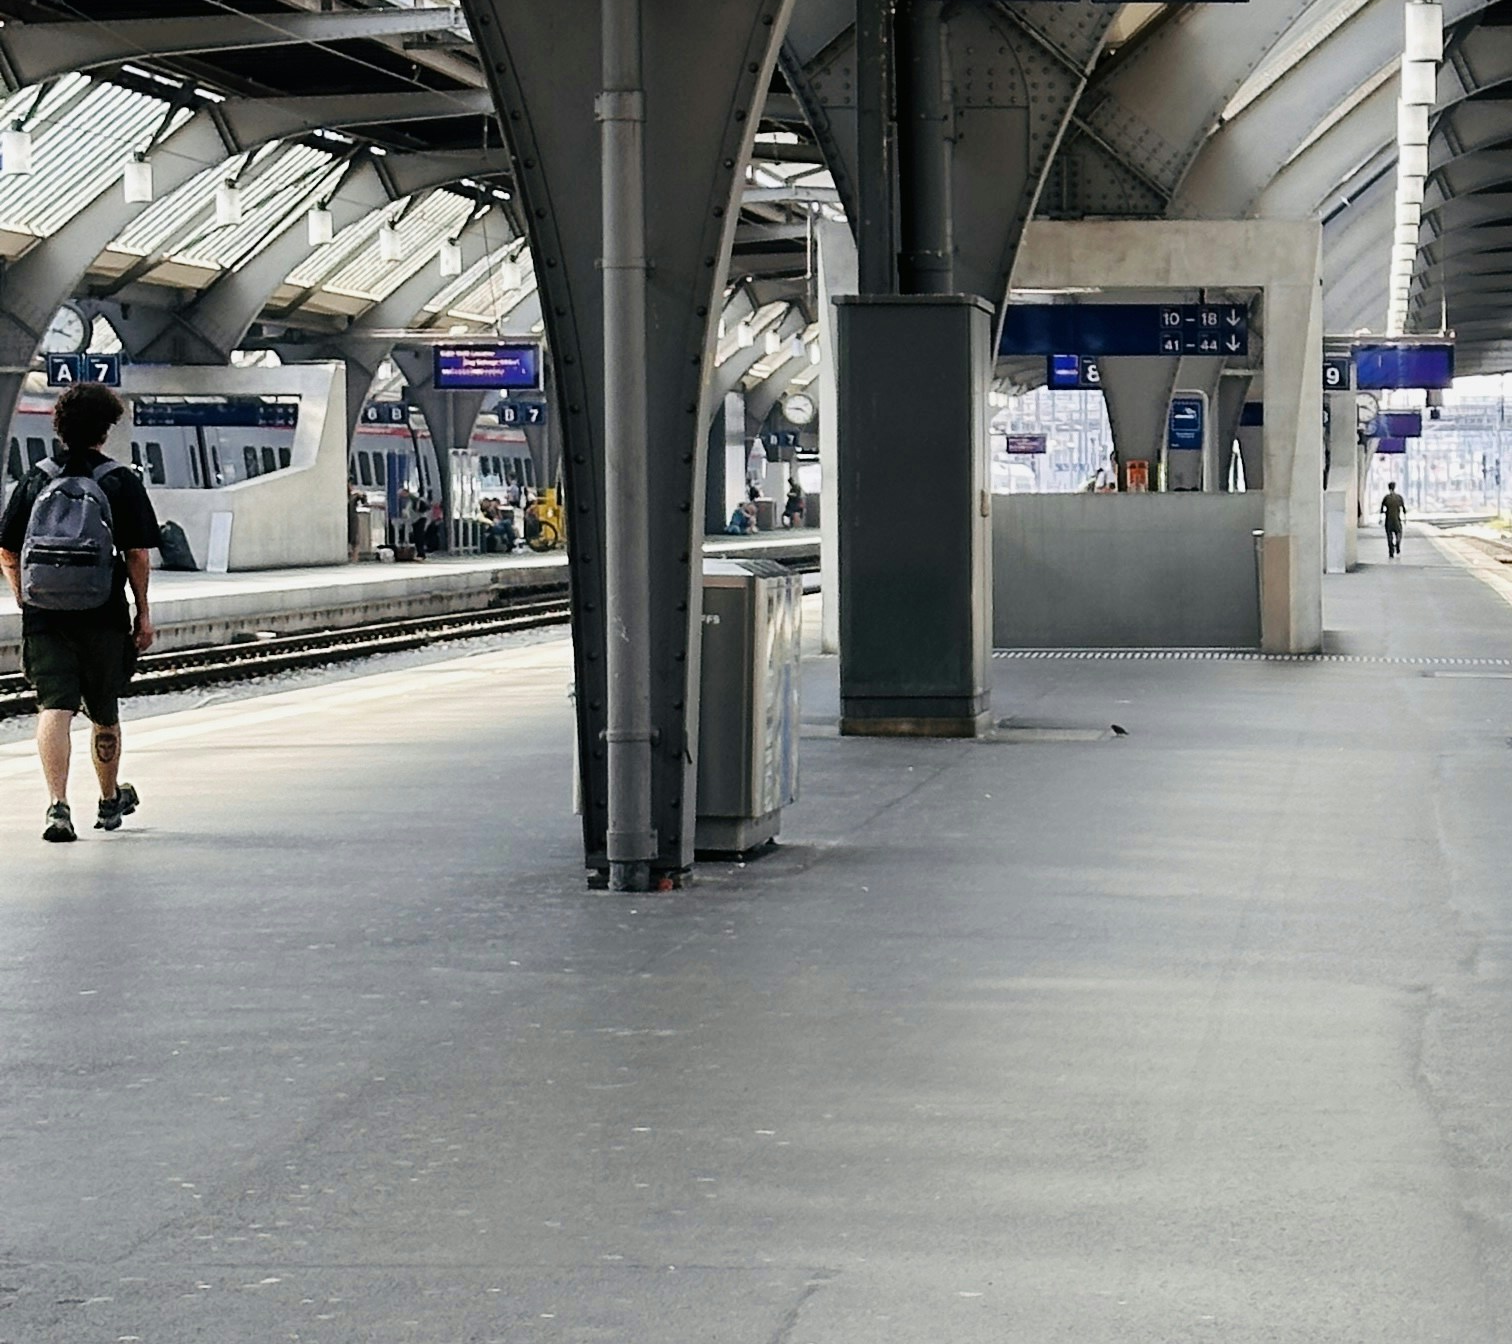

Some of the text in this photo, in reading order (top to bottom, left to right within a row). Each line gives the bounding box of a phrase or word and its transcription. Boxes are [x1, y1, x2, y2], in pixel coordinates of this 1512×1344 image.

[1163, 312, 1180, 325] 10
[1201, 312, 1217, 326] 18
[1164, 339, 1179, 351] 41
[1200, 339, 1217, 351] 44
[57, 363, 72, 382] A
[94, 363, 109, 382] 7
[1087, 364, 1100, 382] 8
[1326, 367, 1340, 385] 9
[529, 408, 539, 422] 7
